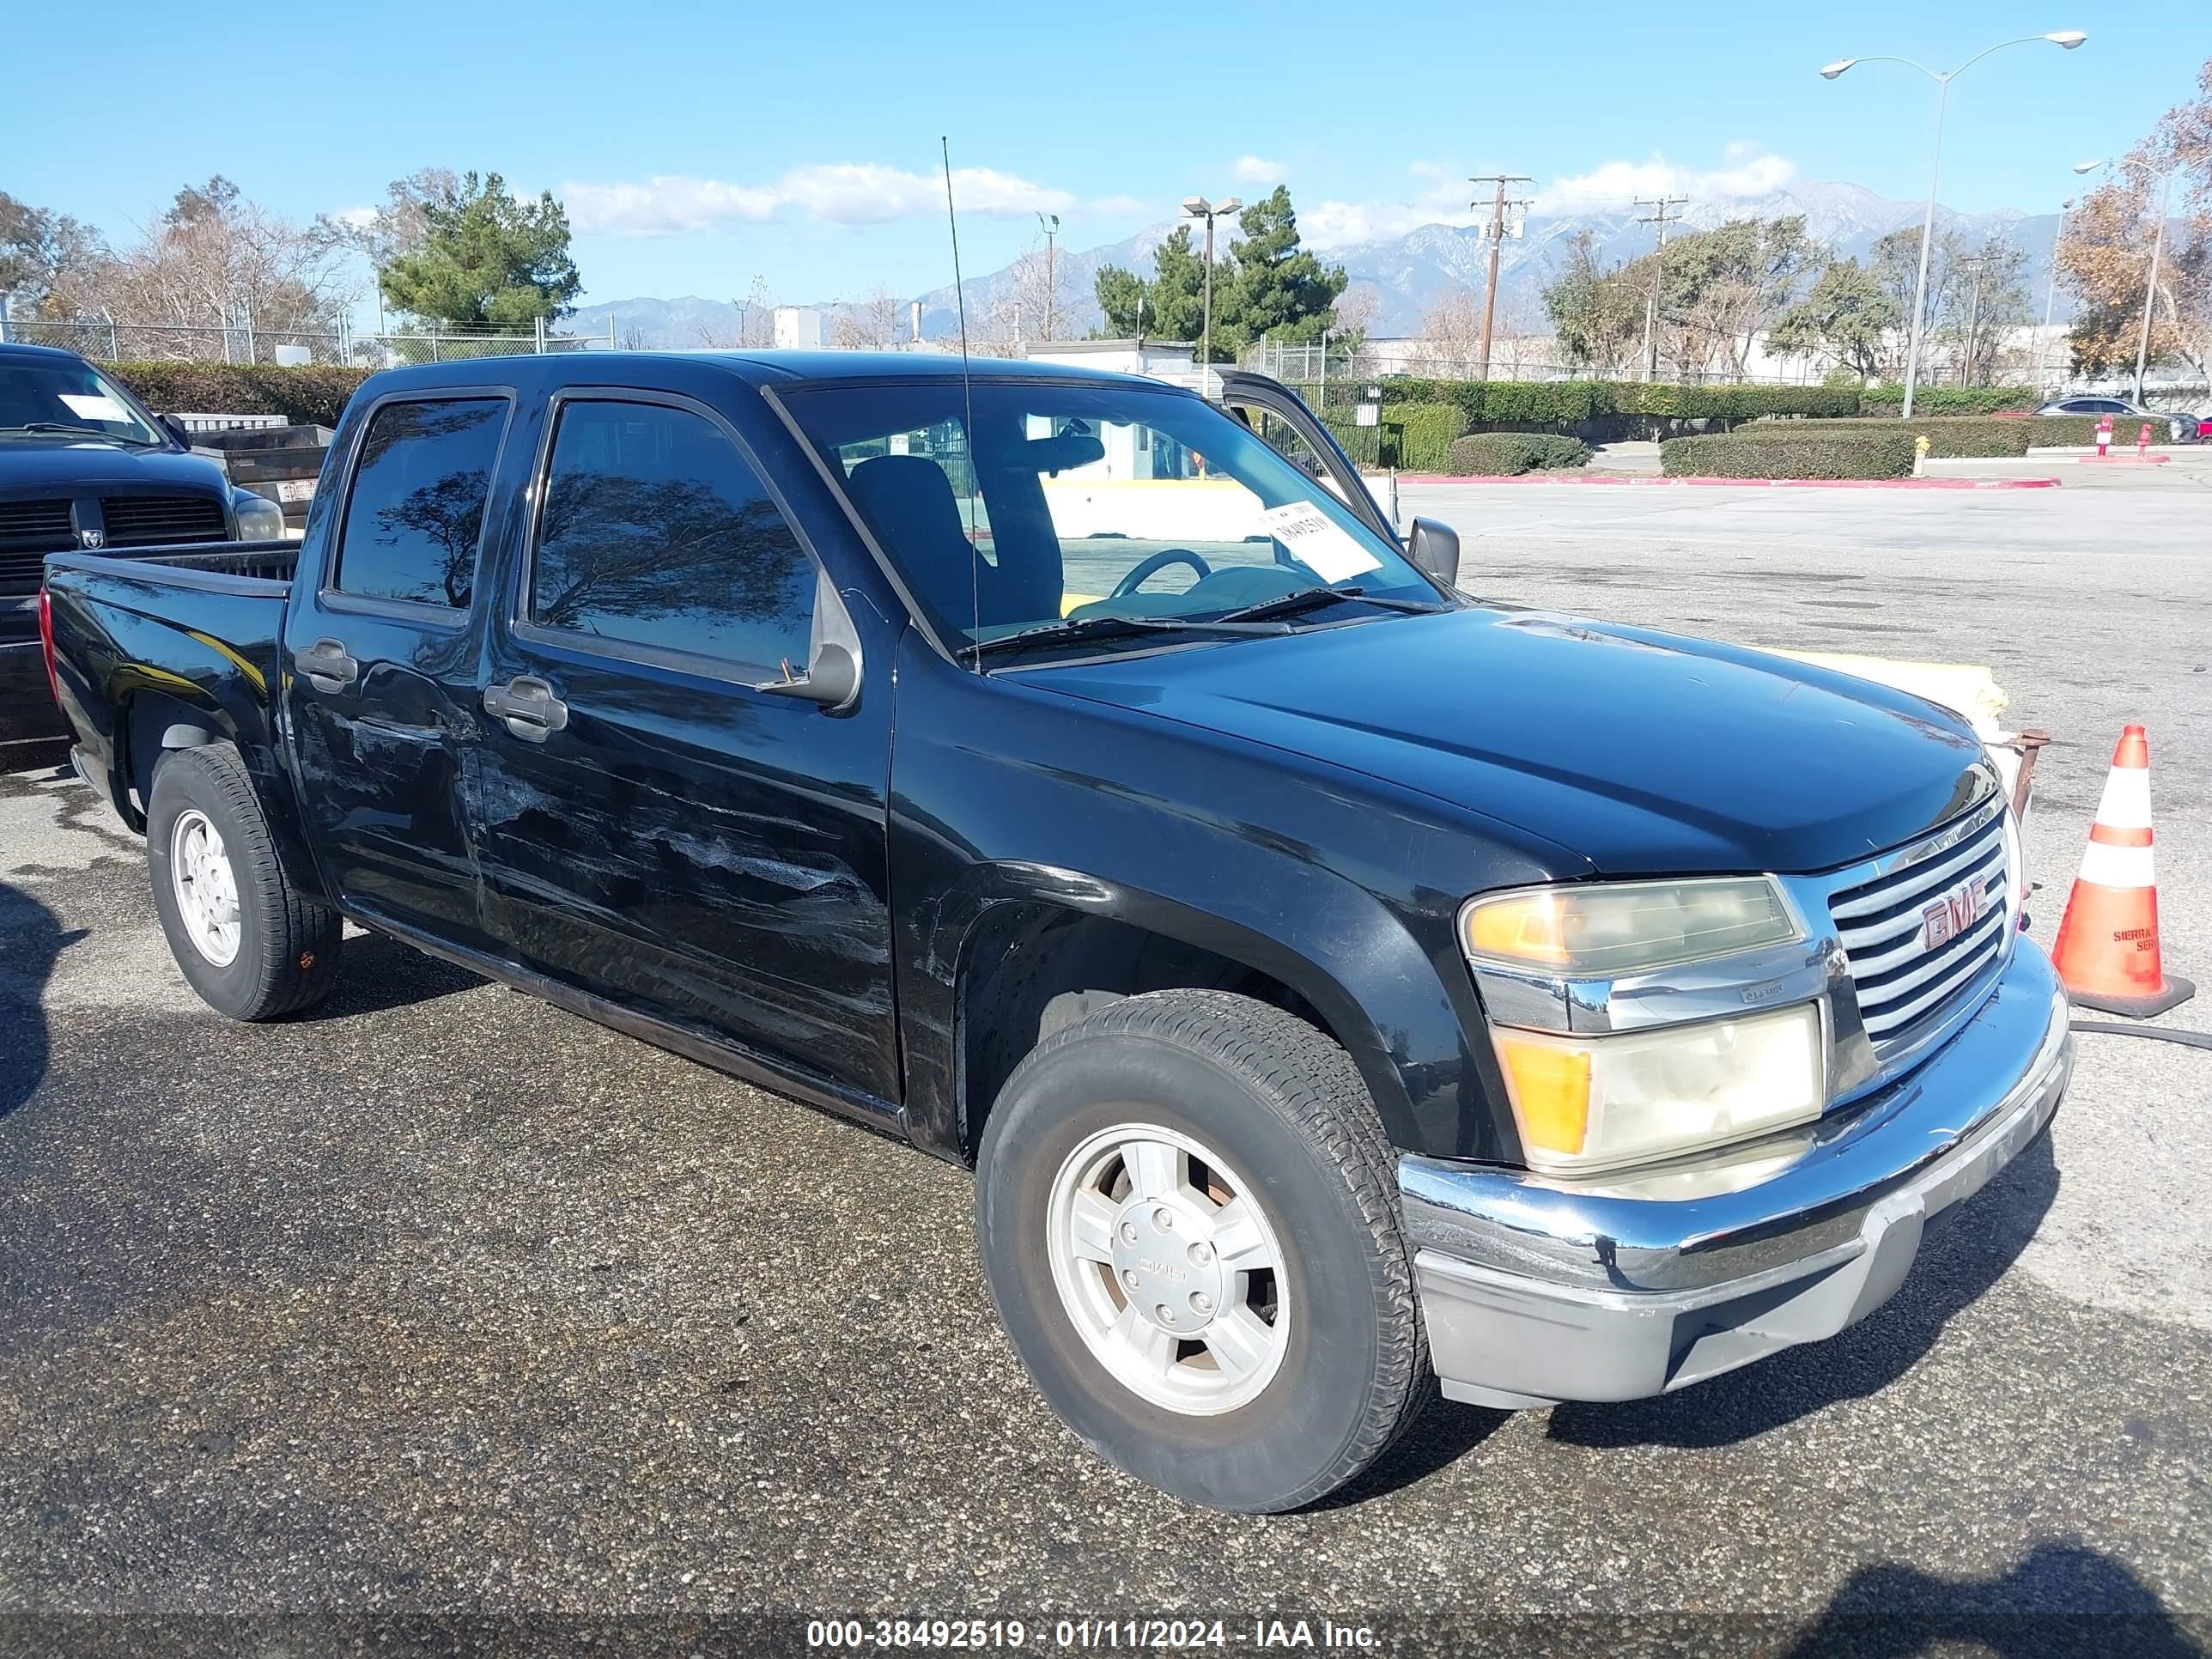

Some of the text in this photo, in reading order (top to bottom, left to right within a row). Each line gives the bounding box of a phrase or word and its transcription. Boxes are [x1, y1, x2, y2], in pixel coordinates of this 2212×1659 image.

[1276, 517, 1328, 540] 38492519
[1923, 875, 1990, 951] GMC
[2113, 928, 2152, 942] SIERRA
[1139, 1256, 1188, 1283] GMC
